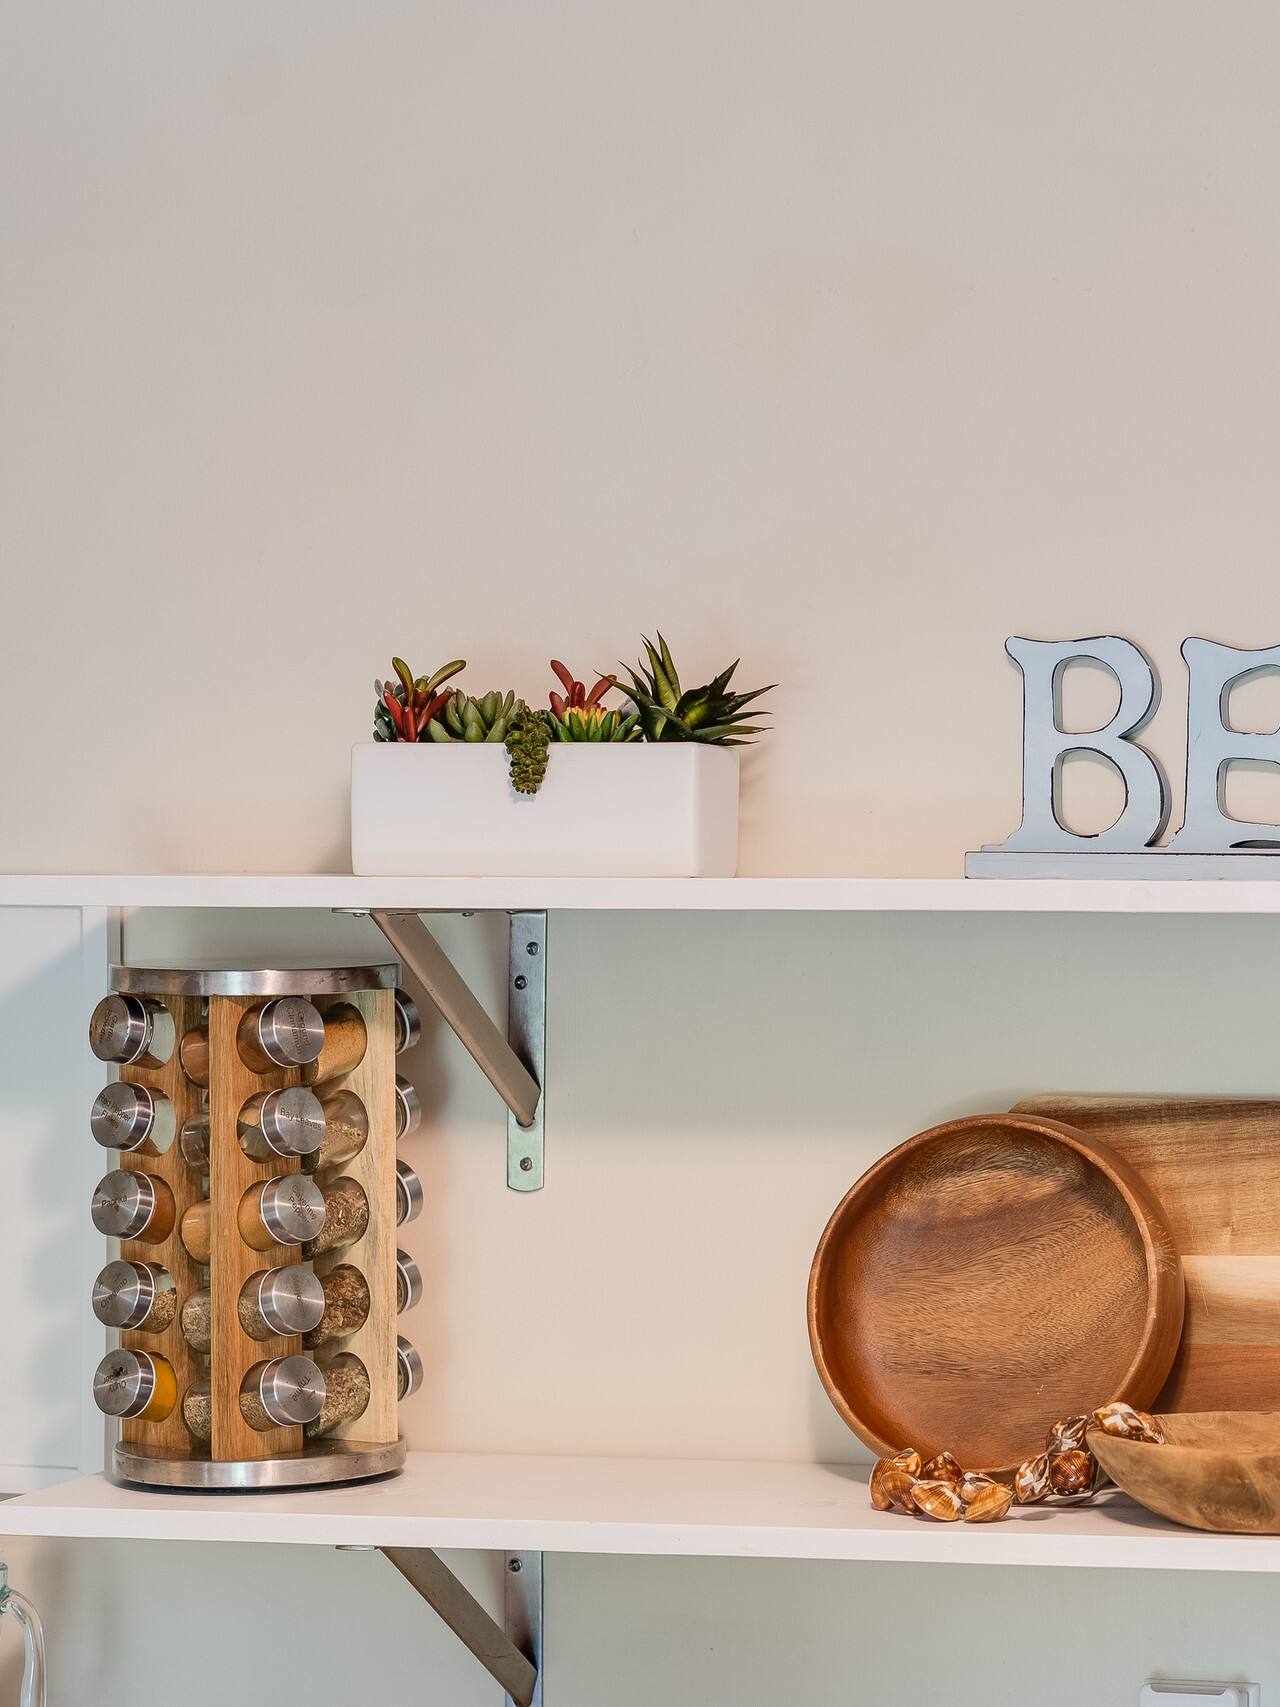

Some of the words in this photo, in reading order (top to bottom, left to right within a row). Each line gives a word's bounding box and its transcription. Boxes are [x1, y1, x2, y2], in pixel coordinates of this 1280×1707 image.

[106, 1015, 118, 1041] Garlic
[286, 1006, 303, 1055] Cinnamon
[298, 1009, 312, 1047] Ground
[280, 1107, 295, 1122] Bay
[296, 1114, 322, 1130] Leaves
[101, 1195, 128, 1208] Papka
[288, 1195, 311, 1224] Pepper
[292, 1184, 317, 1220] Cayenne
[103, 1366, 128, 1384] Pder
[108, 1380, 127, 1394] Curry
